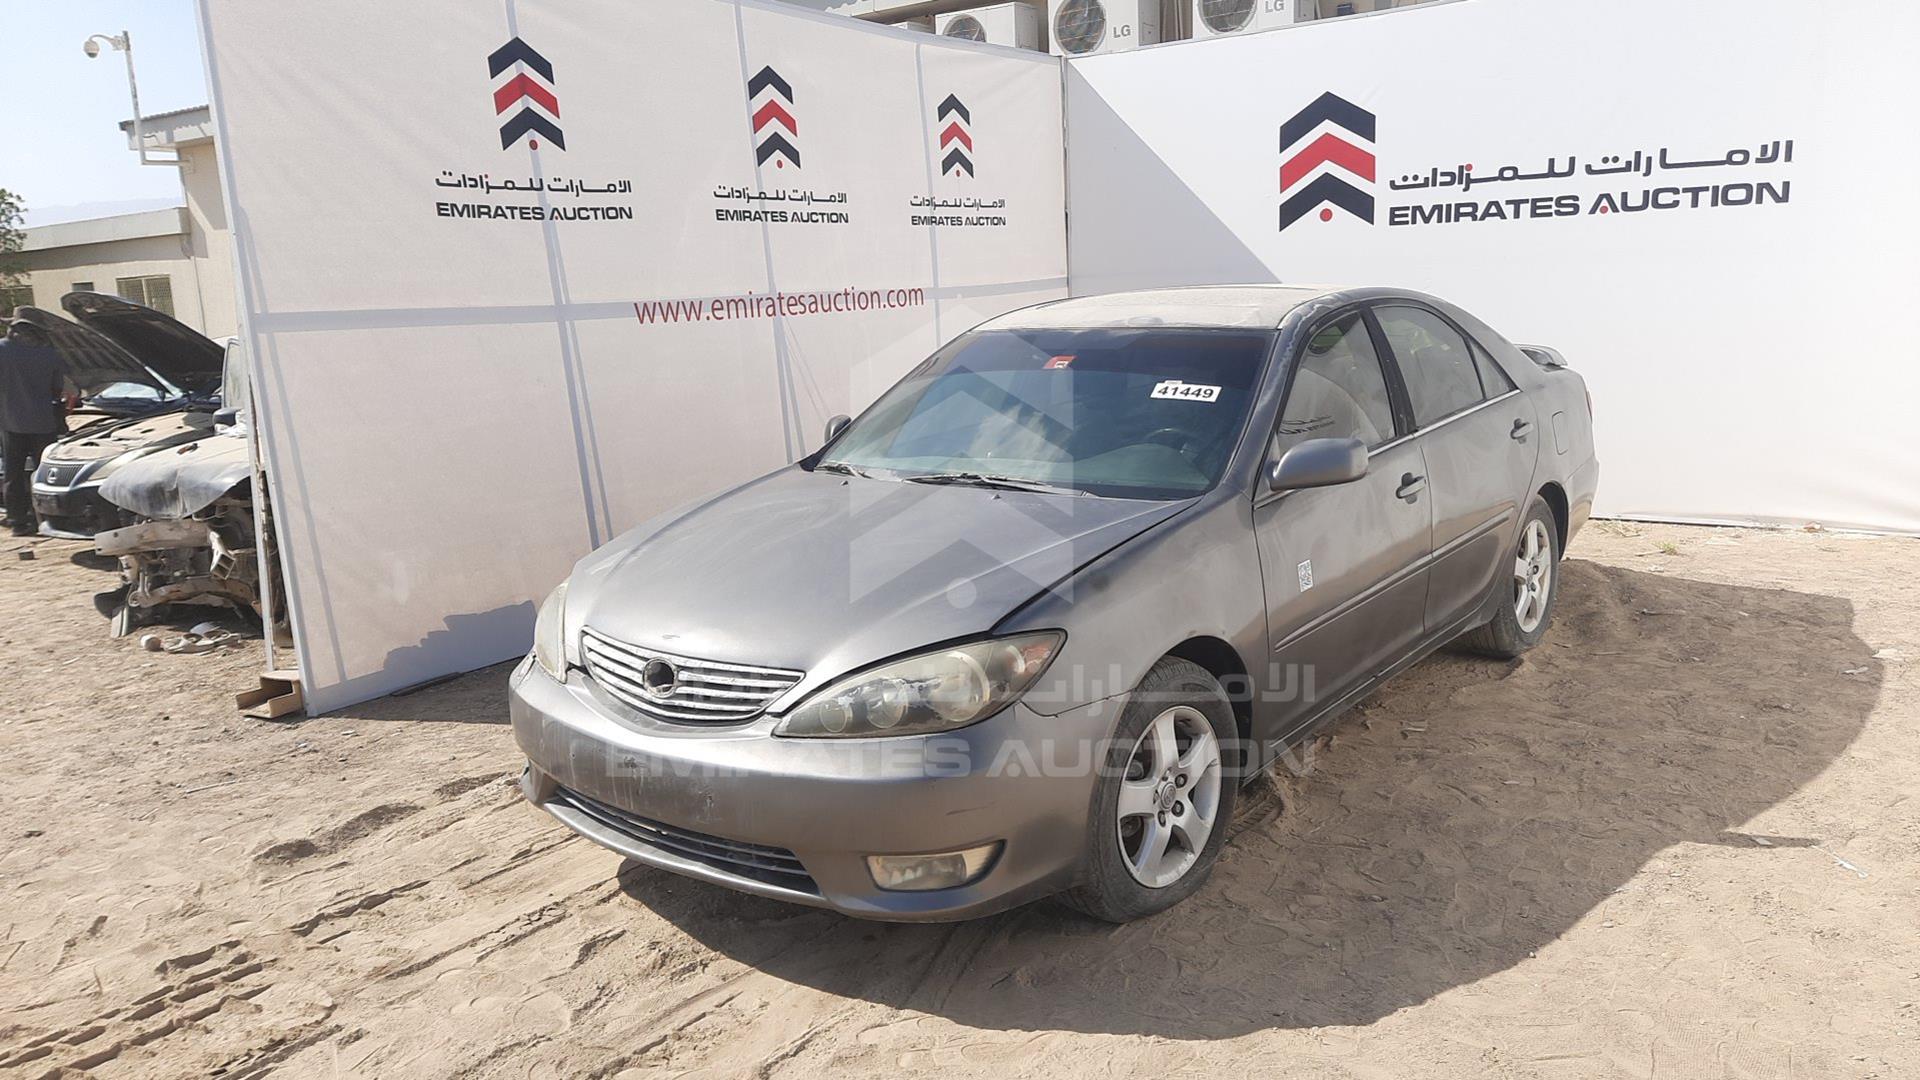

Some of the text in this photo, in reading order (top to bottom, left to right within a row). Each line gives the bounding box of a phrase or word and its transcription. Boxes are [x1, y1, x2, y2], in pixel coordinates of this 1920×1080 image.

[1265, 0, 1285, 13] LG
[1113, 24, 1131, 39] LG
[1389, 180, 1791, 227] EMIRATES AUCTION
[436, 202, 634, 221] EMIRATES AUCTION
[715, 209, 849, 223] EMIRATES AUCTION
[911, 215, 1006, 226] EMIRATES AUCTION
[633, 285, 925, 325] www.emiratesauction.com
[1157, 386, 1214, 399] 41449
